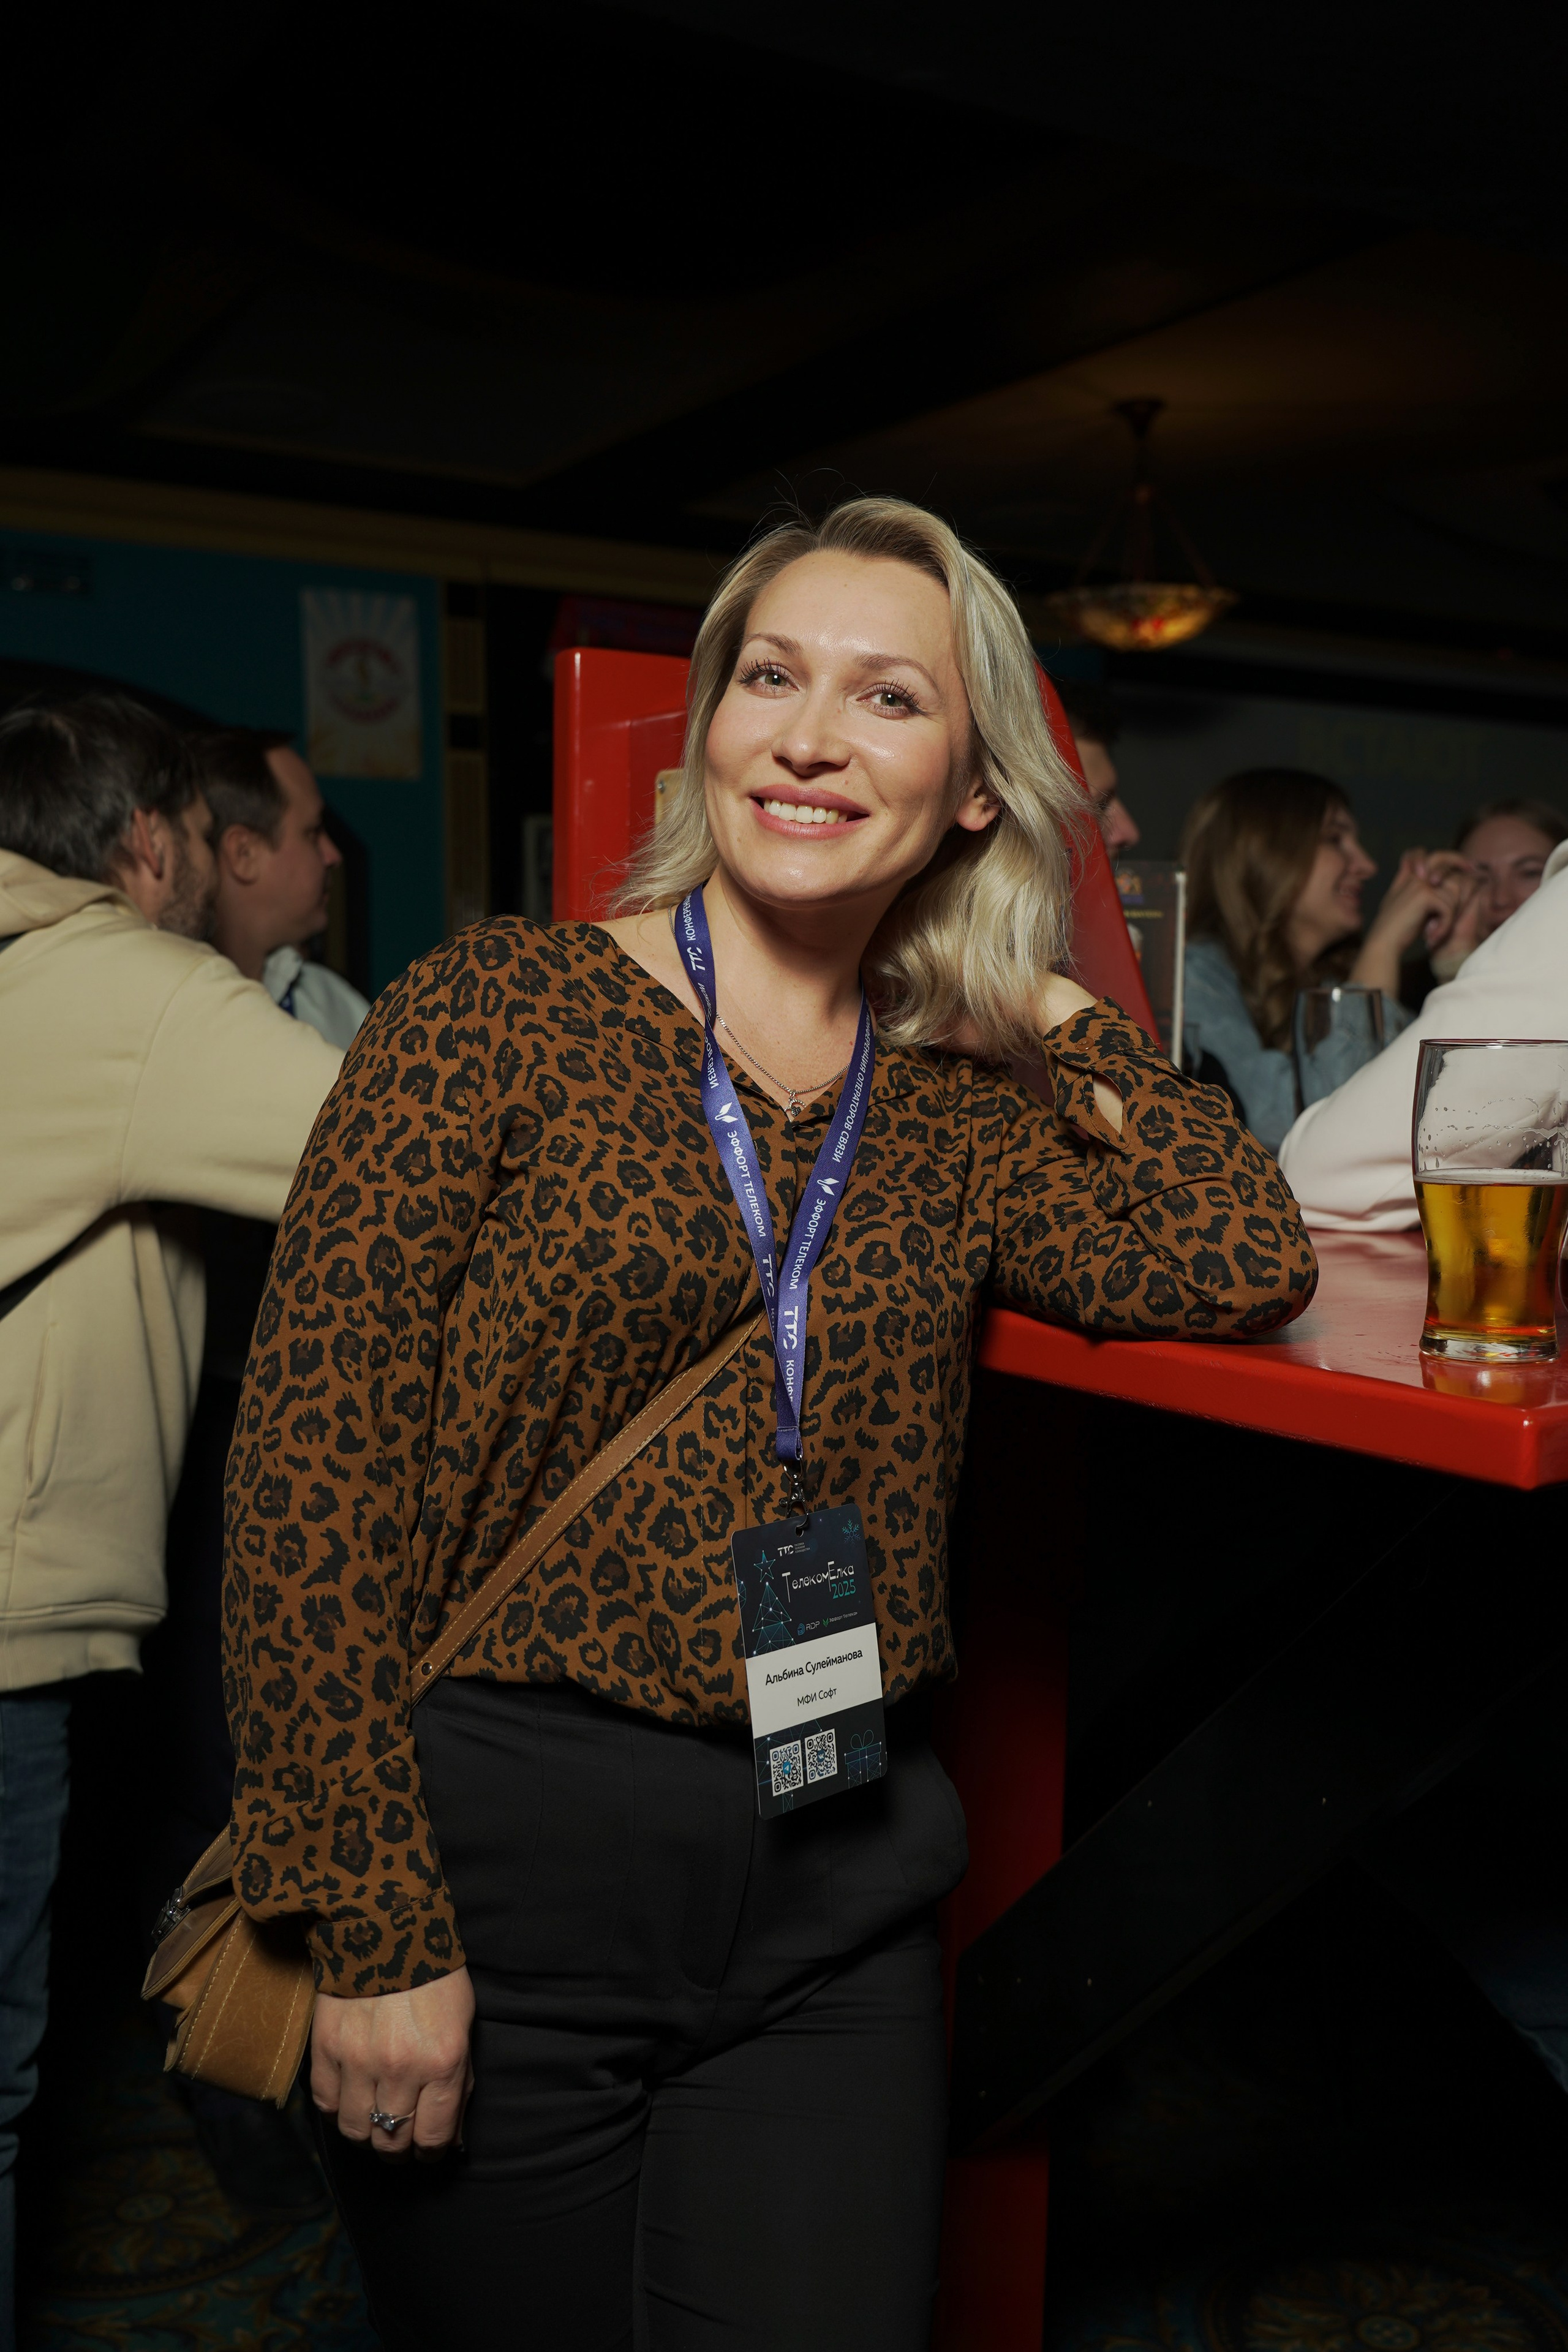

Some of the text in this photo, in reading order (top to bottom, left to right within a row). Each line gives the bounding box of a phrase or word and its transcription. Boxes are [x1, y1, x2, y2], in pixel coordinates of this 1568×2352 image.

[707, 1057, 720, 1089] СВЯЗИ
[845, 1072, 865, 1131] ОПЕРАТОРОВ
[832, 1129, 850, 1163] СВЯЗИ
[727, 1130, 766, 1237] ЭФФОРТ ТЕЛЕКОМ
[789, 1198, 826, 1289] ЭФФОРТ ТЕЛЕКОМ
[783, 1305, 799, 1349] ТТС
[831, 1579, 856, 1599] 2025
[805, 1621, 820, 1630] RDP
[765, 1649, 863, 1686] Альбина Сулейманова
[797, 1687, 837, 1706] МФИ Софт
